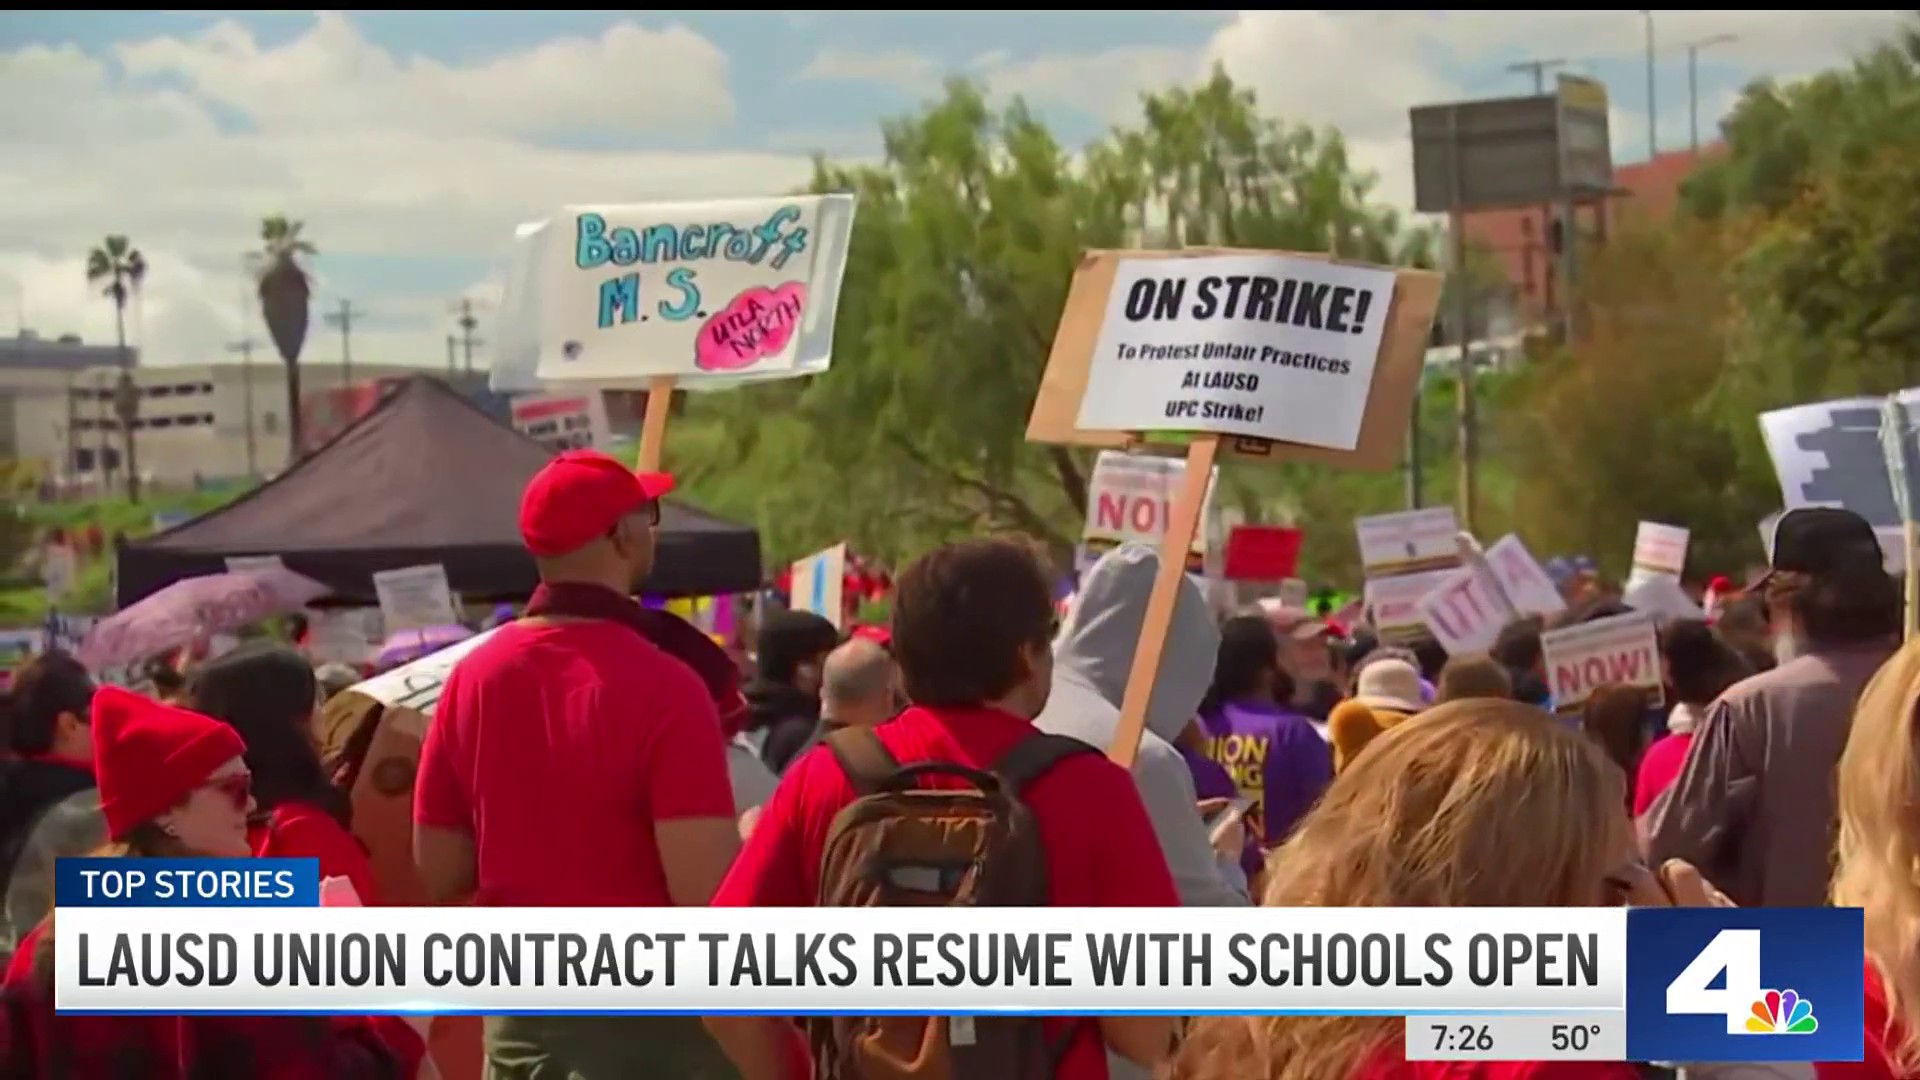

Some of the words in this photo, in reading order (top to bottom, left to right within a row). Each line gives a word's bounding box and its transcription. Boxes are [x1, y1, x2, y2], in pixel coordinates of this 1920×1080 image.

[577, 205, 808, 270] Bancroft
[712, 298, 765, 346] UTLA
[729, 293, 801, 358] NORTH
[1125, 276, 1187, 323] ON
[1191, 275, 1373, 334] STRIKE!
[1117, 342, 1137, 360] To
[1139, 342, 1201, 361] Protest
[1201, 341, 1257, 361] Unfair
[1259, 345, 1352, 375] Practices
[1202, 371, 1260, 393] LAUSD
[1164, 399, 1200, 419] UPC
[1201, 400, 1265, 423] Strike!
[1097, 489, 1169, 534] NO
[1556, 647, 1650, 695] NOW!
